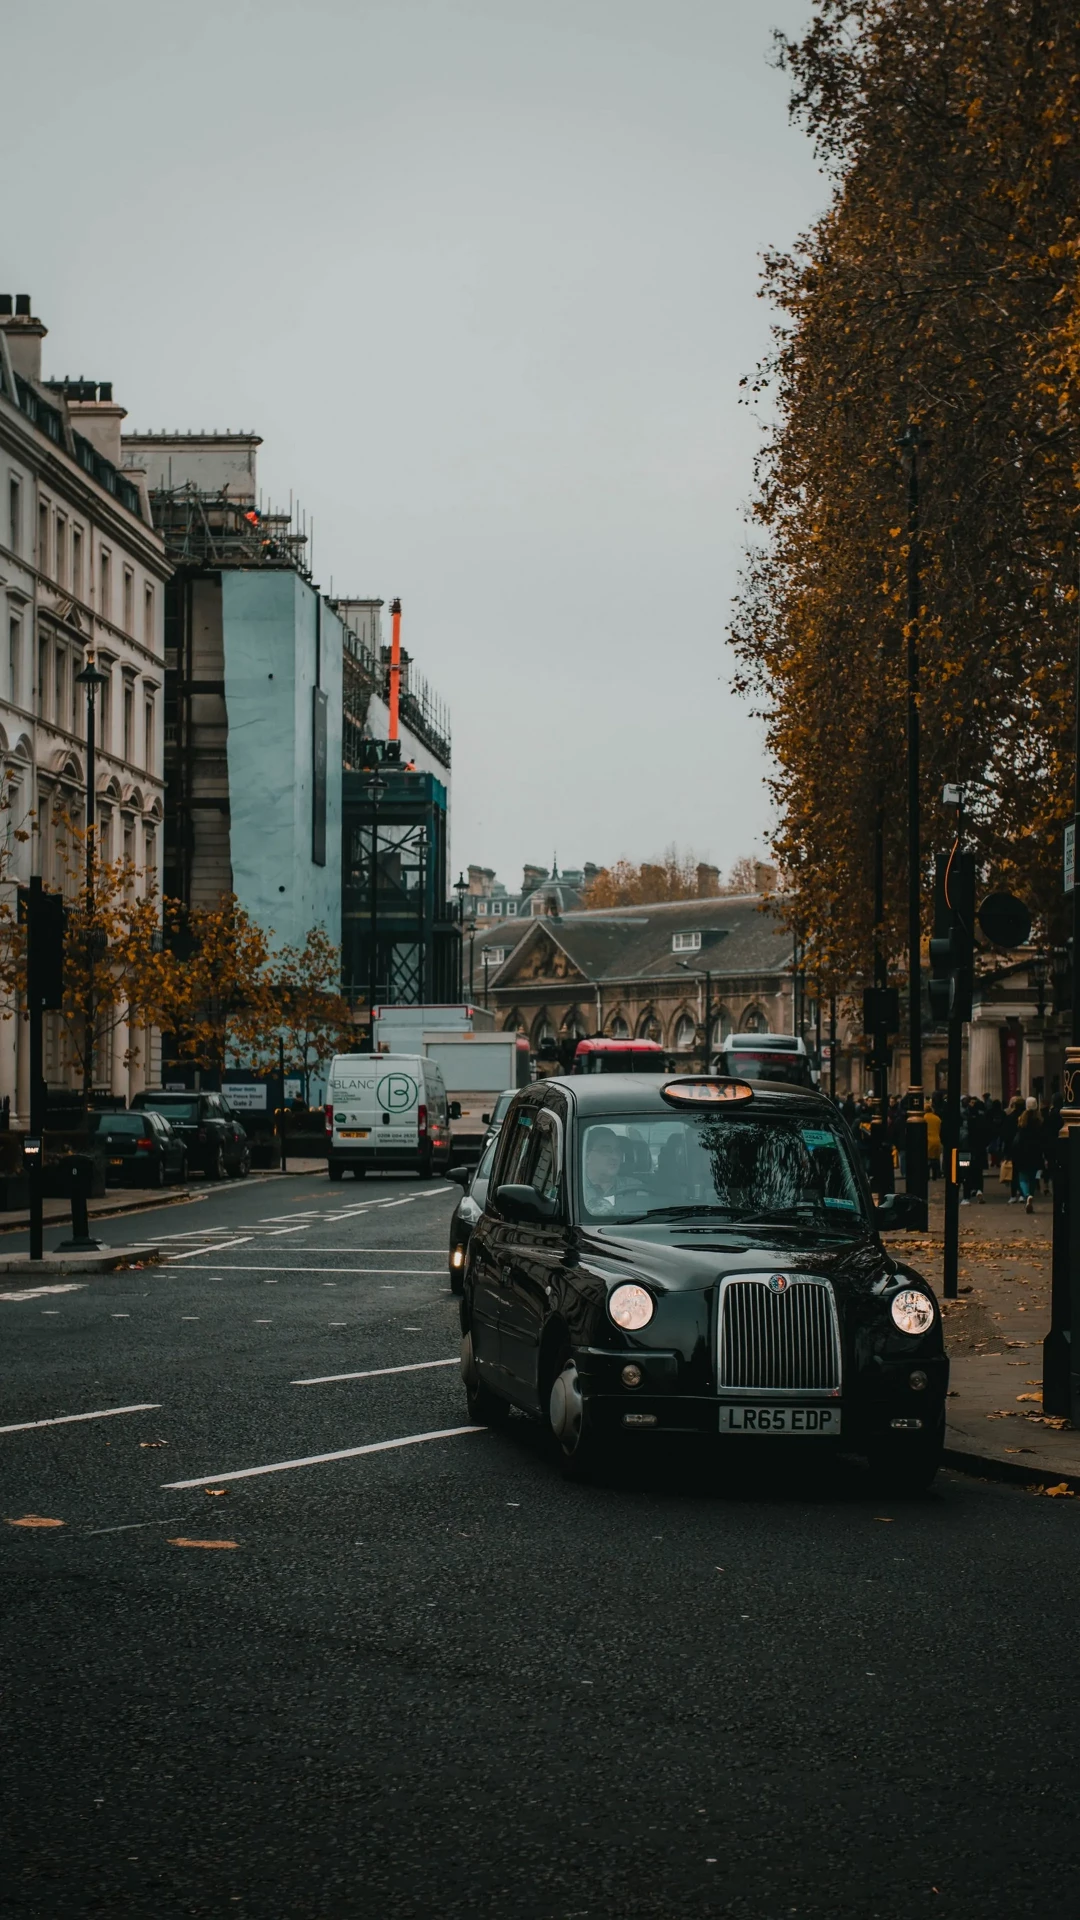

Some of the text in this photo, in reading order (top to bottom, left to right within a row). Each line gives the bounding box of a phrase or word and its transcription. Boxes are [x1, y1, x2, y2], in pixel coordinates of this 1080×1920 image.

[334, 1080, 375, 1090] BLANC
[684, 1083, 737, 1099] TAXI
[728, 1408, 832, 1431] LR65 EDP
